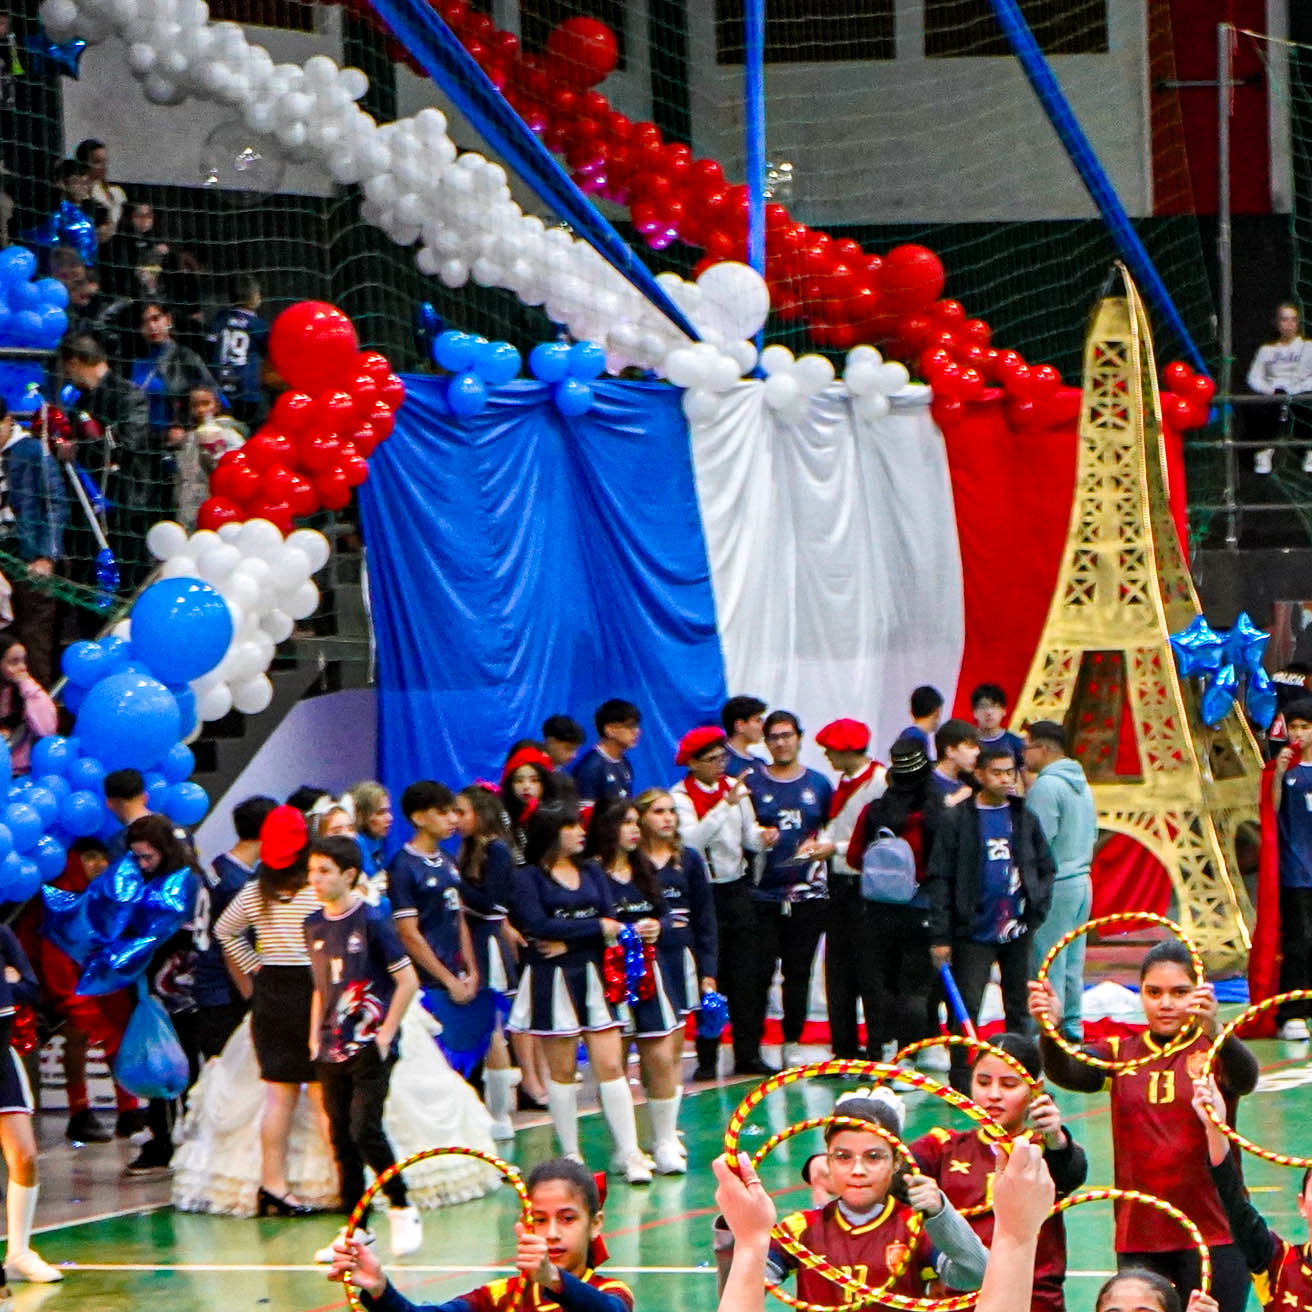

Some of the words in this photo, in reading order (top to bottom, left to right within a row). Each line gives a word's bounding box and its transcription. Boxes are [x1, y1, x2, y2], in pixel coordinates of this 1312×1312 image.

[221, 328, 251, 366] 19
[777, 809, 801, 831] 24
[986, 838, 1011, 861] 25
[1148, 1070, 1175, 1104] 13
